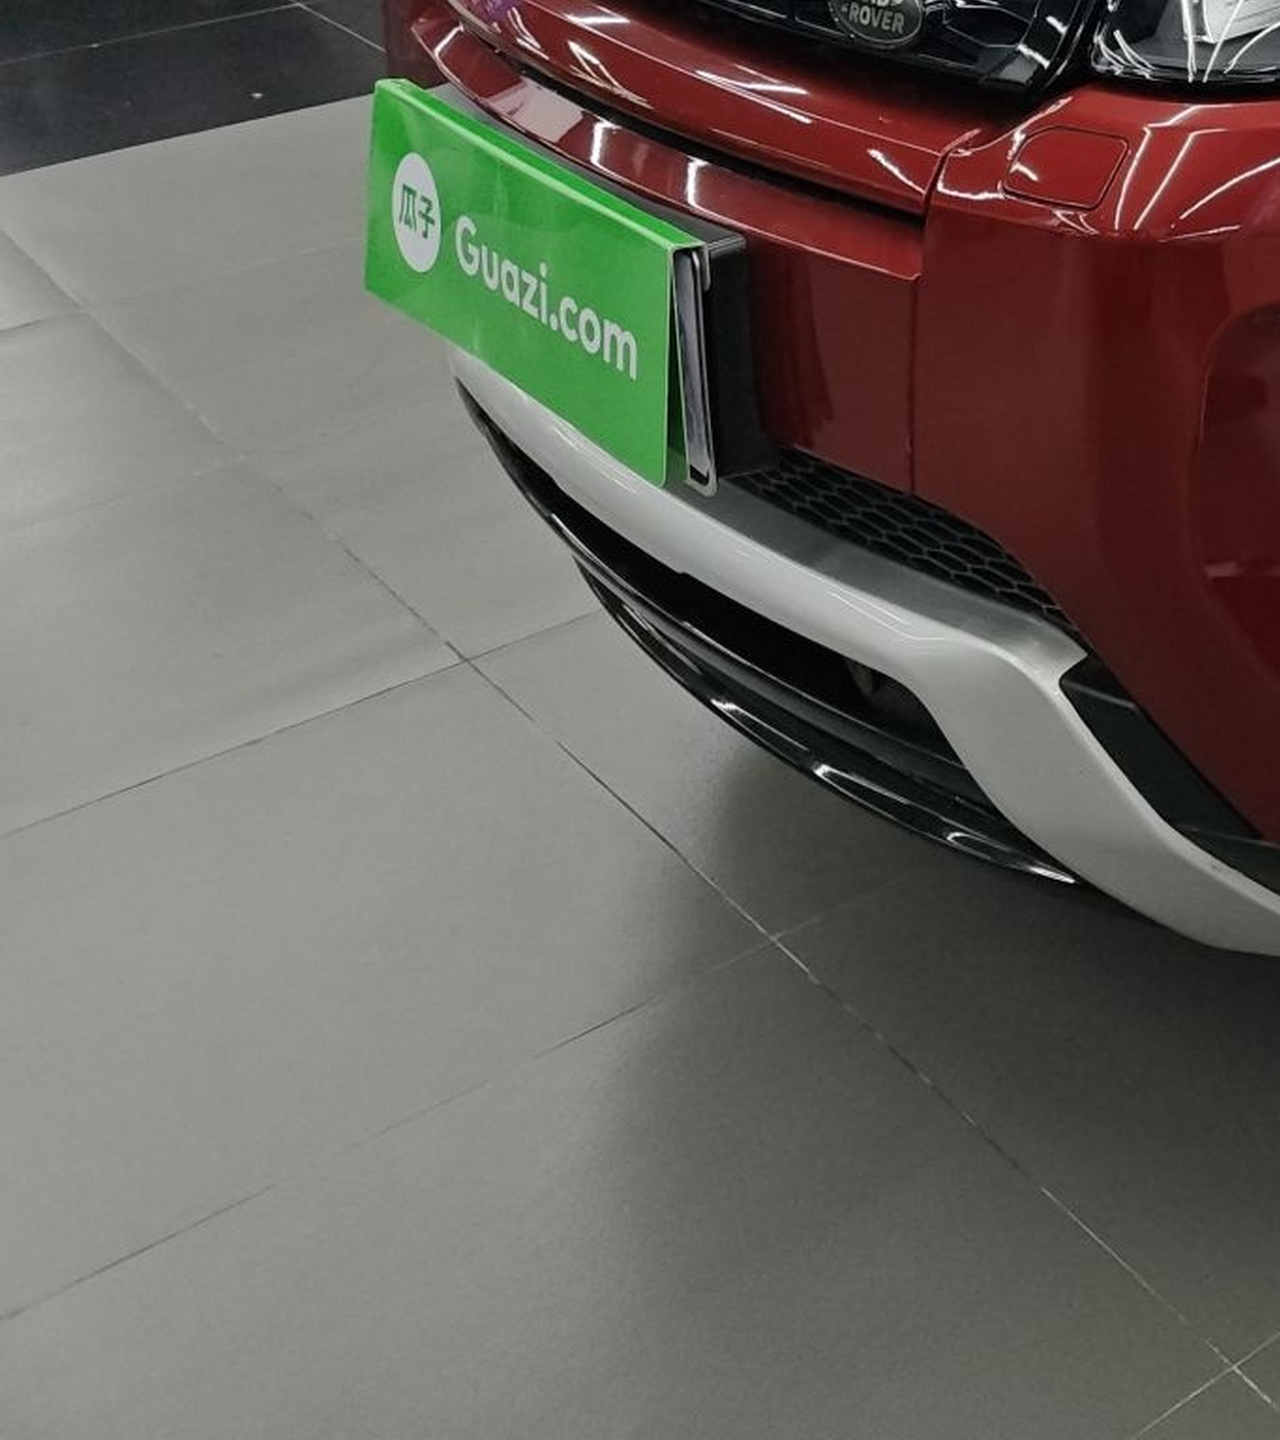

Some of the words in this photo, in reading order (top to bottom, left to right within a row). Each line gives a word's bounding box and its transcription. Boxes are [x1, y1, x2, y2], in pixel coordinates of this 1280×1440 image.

[848, 1, 905, 34] ROVER
[398, 182, 436, 240] 瓜子
[454, 214, 638, 381] Guazi.com
